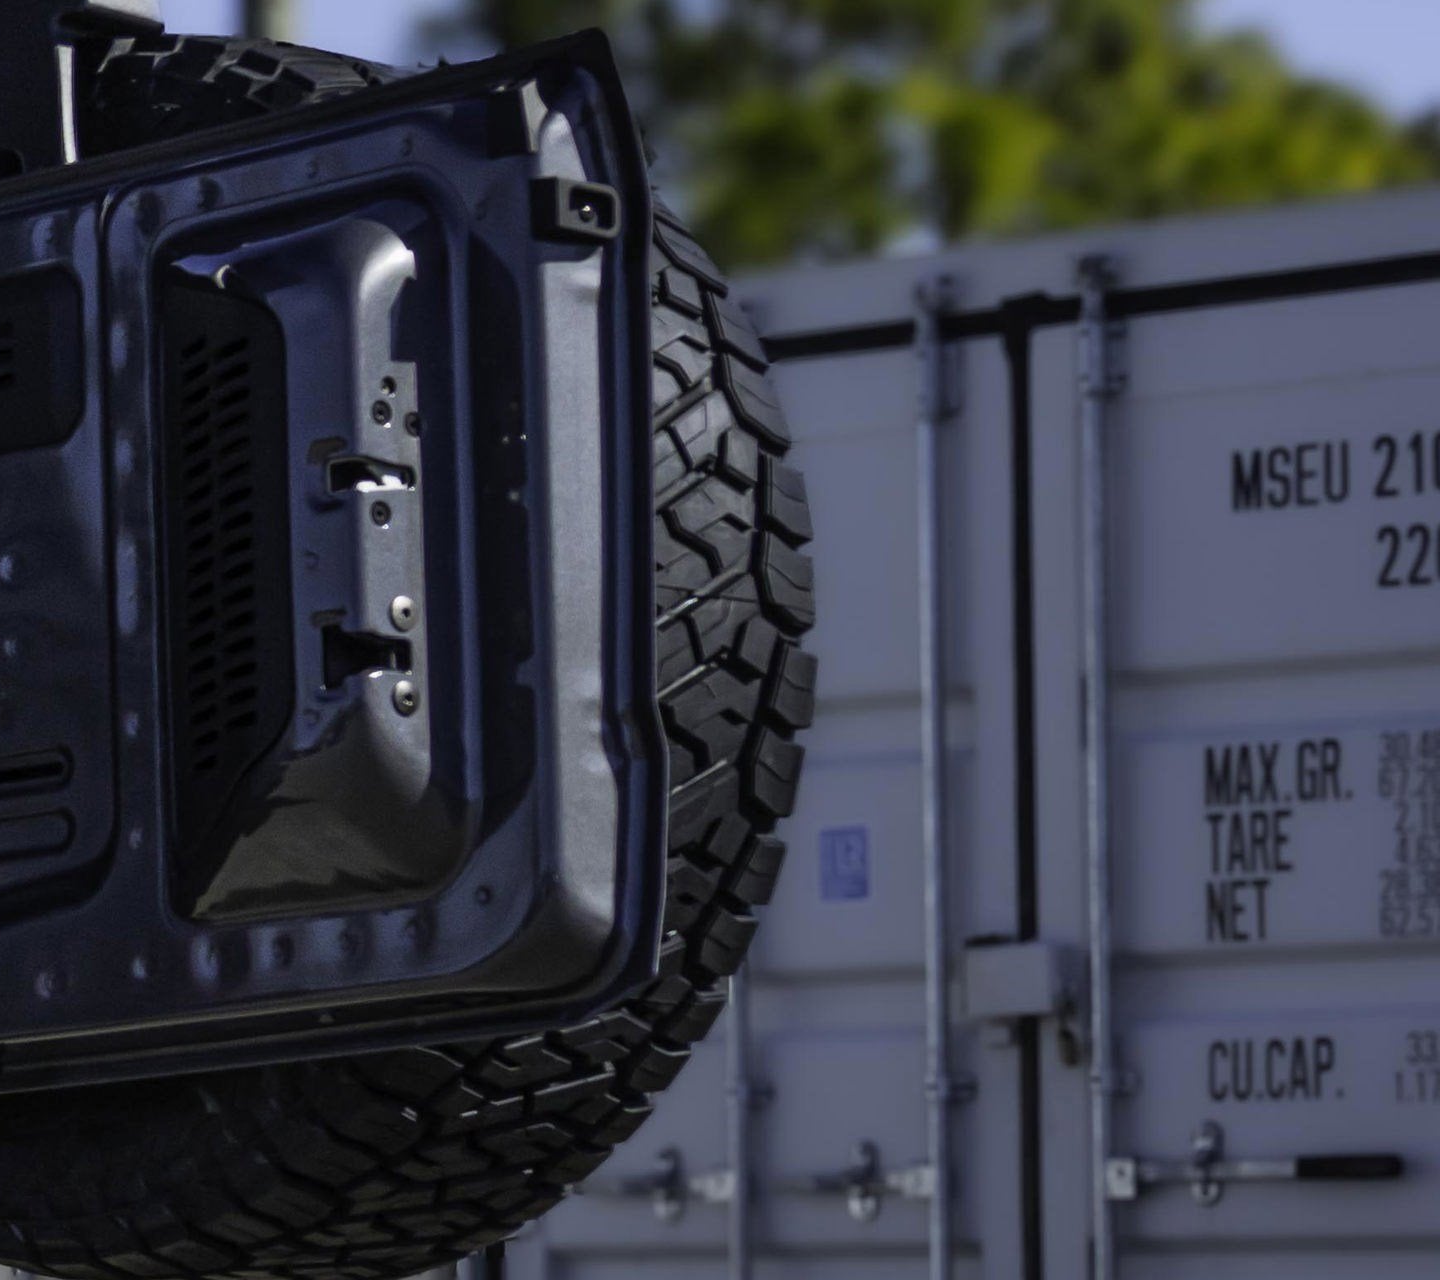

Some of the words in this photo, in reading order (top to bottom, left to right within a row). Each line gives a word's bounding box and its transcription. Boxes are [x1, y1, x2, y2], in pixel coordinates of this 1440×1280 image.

[1231, 440, 1351, 512] MSEU
[1372, 428, 1440, 500] 21
[1375, 521, 1440, 590] 22
[1204, 737, 1353, 806] MAX.GR.
[1205, 808, 1293, 874] TARE
[1205, 877, 1271, 942] NET
[1207, 1034, 1346, 1104] CU.CAP.
